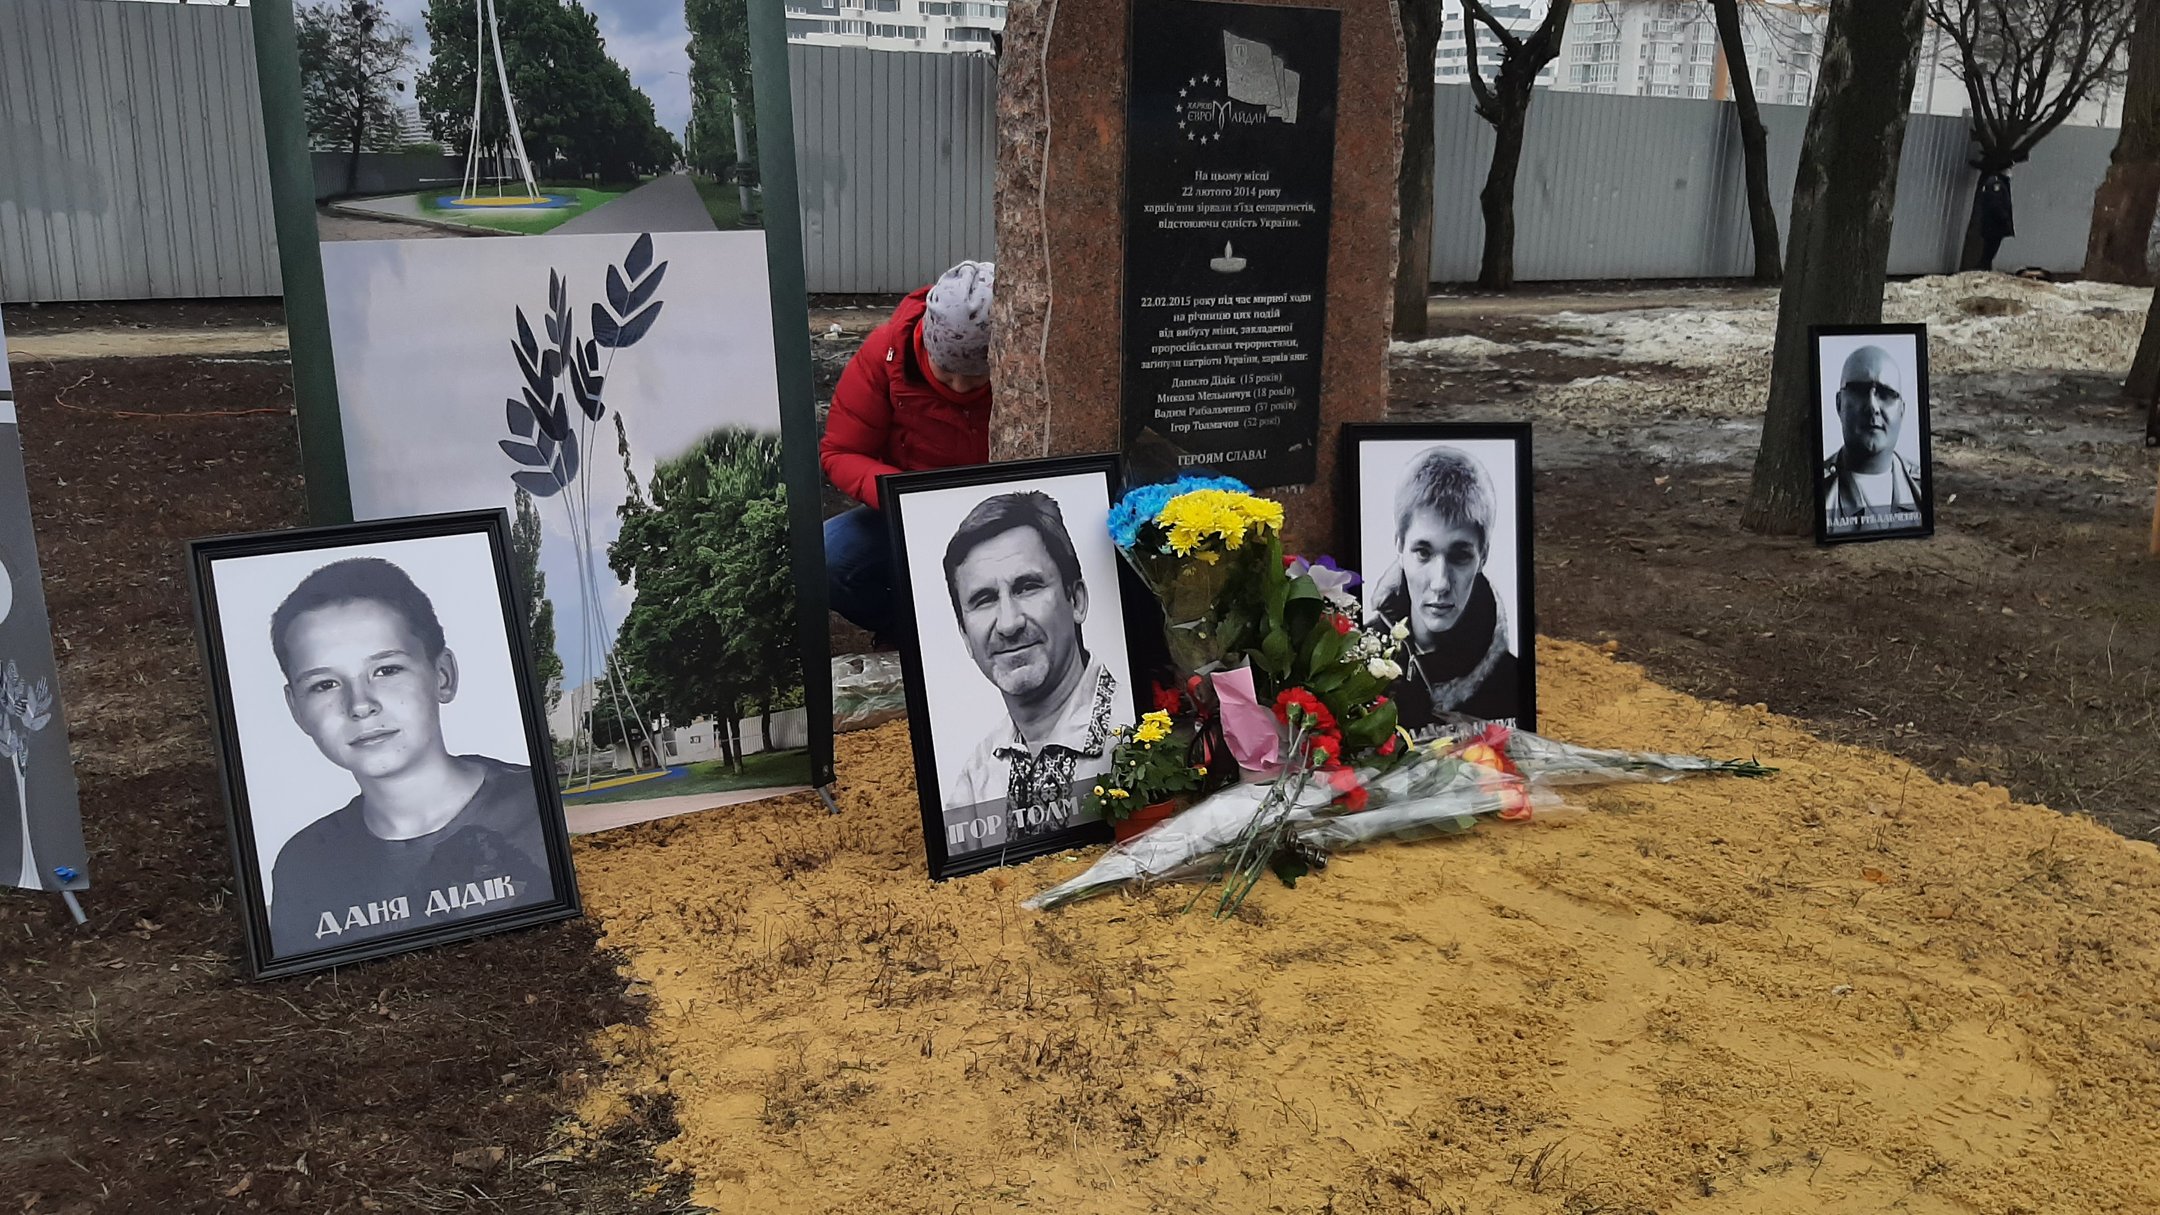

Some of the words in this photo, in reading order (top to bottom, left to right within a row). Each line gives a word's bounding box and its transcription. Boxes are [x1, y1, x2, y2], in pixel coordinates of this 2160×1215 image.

[1195, 170, 1208, 181] На
[1210, 172, 1242, 183] цьому
[1244, 170, 1269, 182] місці
[1182, 187, 1193, 197] 22
[1195, 188, 1232, 198] лютого
[1234, 186, 1256, 197] 2014
[1258, 187, 1281, 199] року
[1255, 202, 1316, 214] сепаратистів,
[1158, 218, 1219, 229] відстоюючи
[1221, 218, 1257, 229] єдність
[1259, 217, 1301, 229] України.
[1140, 296, 1191, 308] 22.02.2015
[1193, 297, 1216, 308] року
[1218, 294, 1233, 306] під
[1235, 296, 1251, 305] час
[1253, 293, 1288, 306] мирної
[1173, 313, 1185, 322] на
[1187, 311, 1231, 324] річницю
[1233, 311, 1251, 322] цих
[1253, 308, 1280, 321] подій
[1158, 327, 1174, 338] від
[1176, 326, 1210, 339] вибуху
[1240, 322, 1294, 335] закладеної
[1151, 341, 1232, 355] проросійськими
[1234, 338, 1298, 353] терористами,
[1183, 356, 1222, 368] патріоти
[1171, 377, 1209, 389] Данило
[1210, 375, 1236, 387] Дідік
[1240, 373, 1255, 386] (15
[1255, 372, 1283, 385] років)
[1157, 393, 1195, 404] Микола
[1197, 390, 1251, 402] Мельничук
[1253, 387, 1267, 399] (18
[1268, 385, 1295, 399] років)
[1154, 408, 1187, 419] Вадим
[1188, 405, 1251, 417] Рибальченко
[1170, 422, 1190, 434] Ігор
[1192, 419, 1239, 431] Толмачов
[1178, 451, 1224, 466] ГЕРОЯМ
[1226, 449, 1267, 463] СЛАВА!
[315, 896, 410, 940] ДАНЯ
[424, 875, 515, 917] ДІДІК
